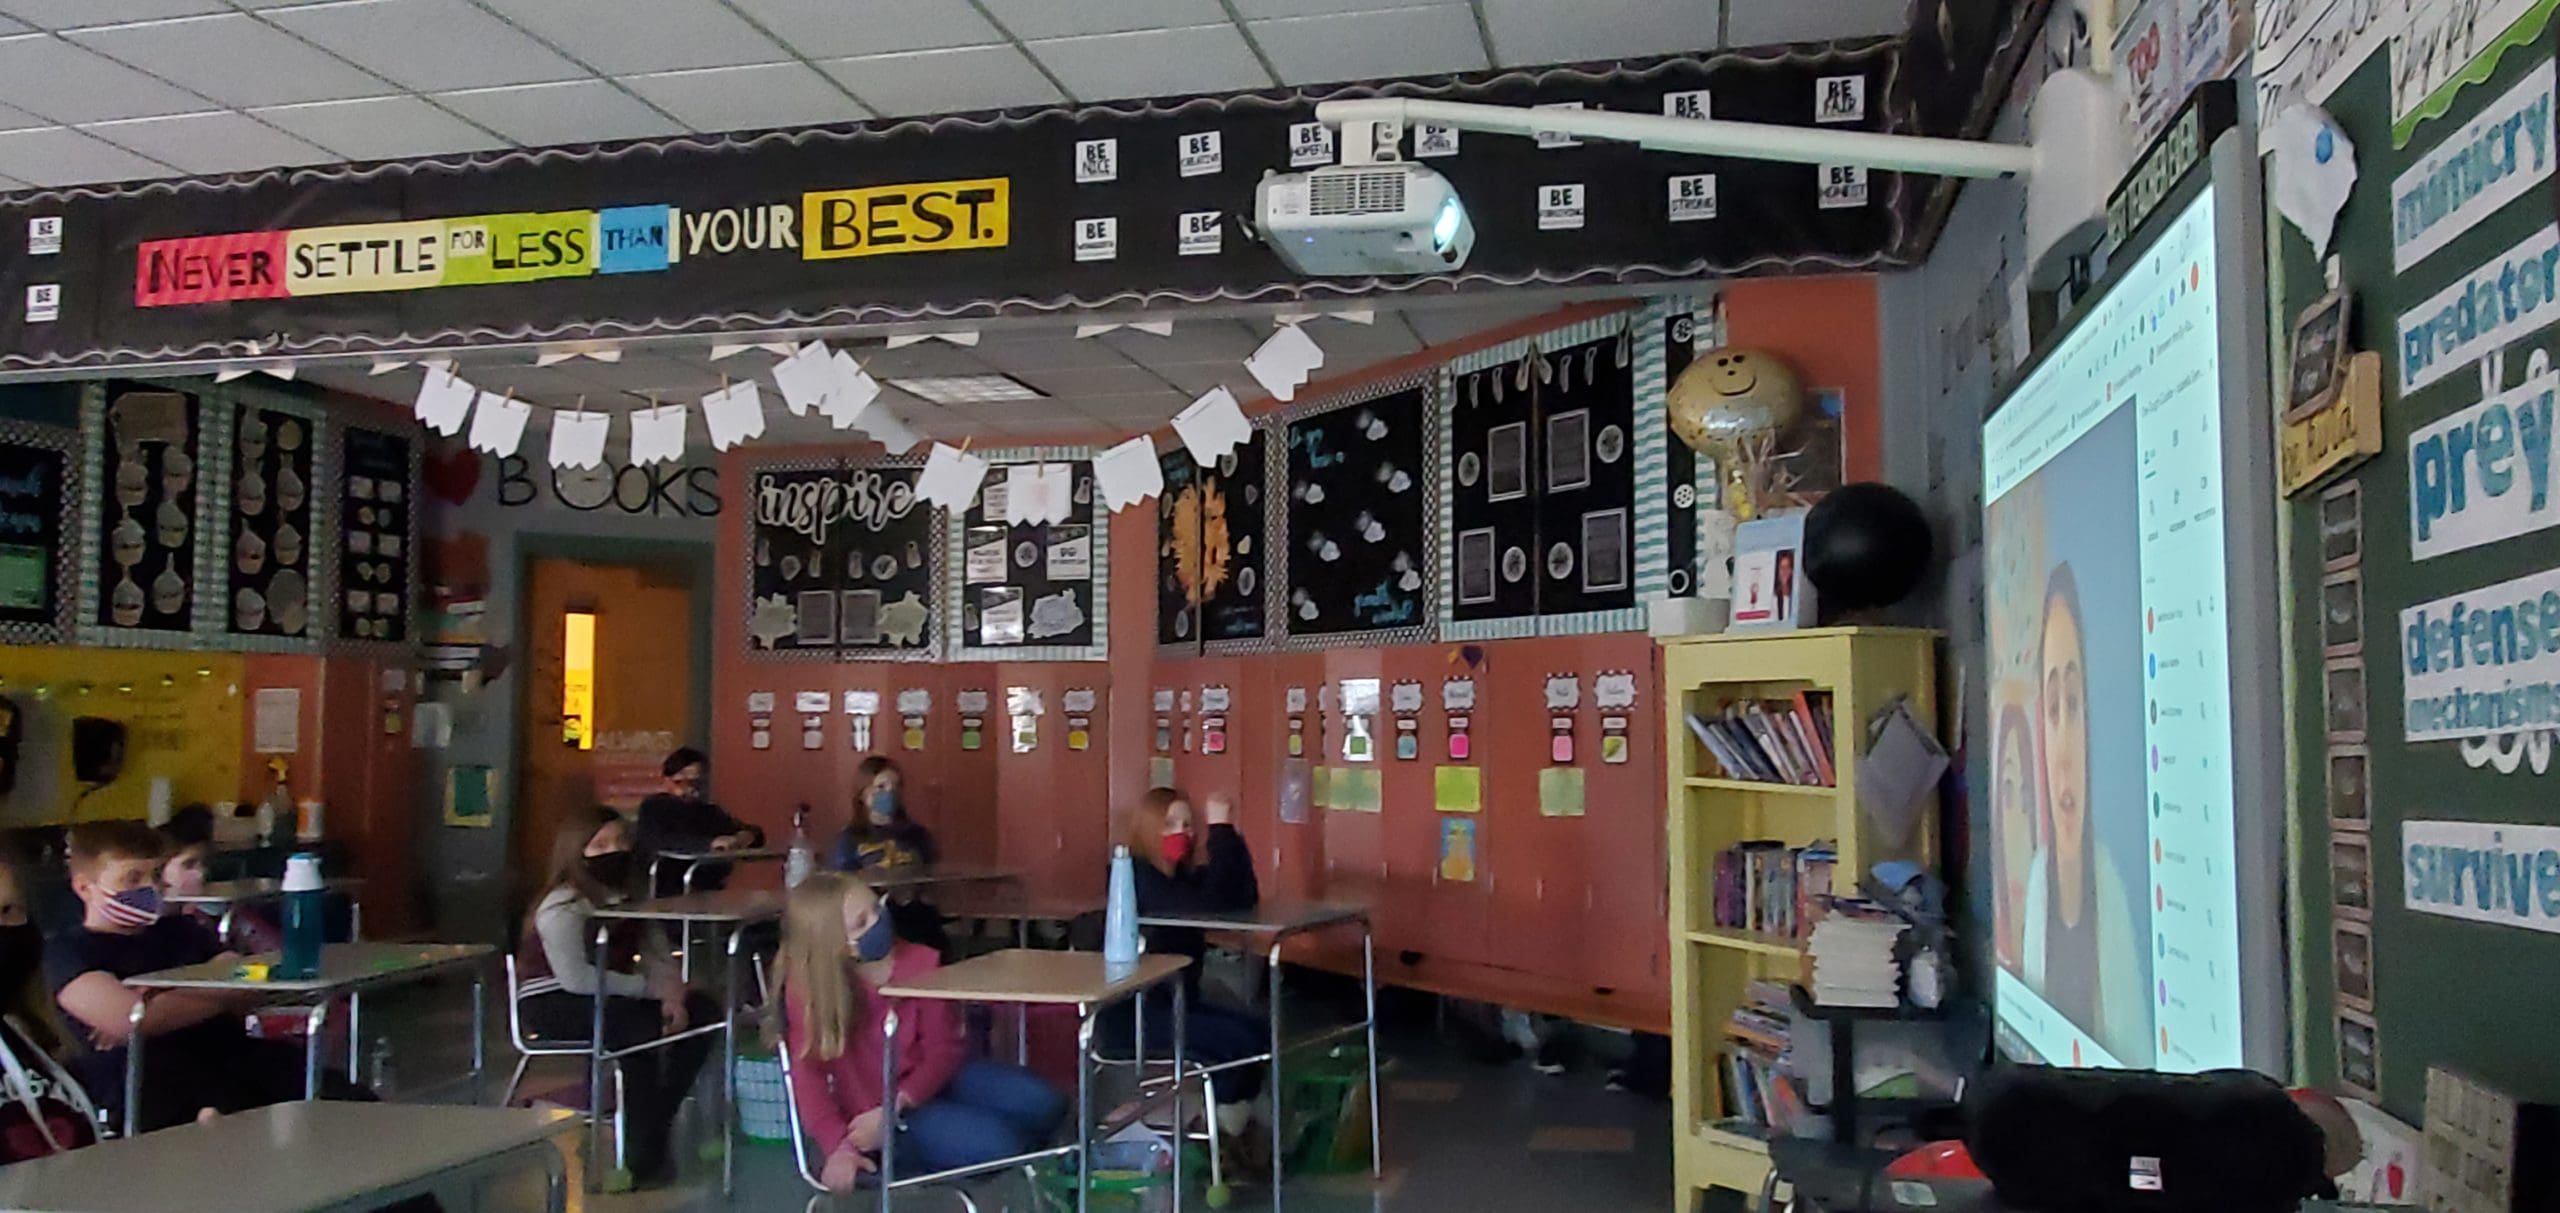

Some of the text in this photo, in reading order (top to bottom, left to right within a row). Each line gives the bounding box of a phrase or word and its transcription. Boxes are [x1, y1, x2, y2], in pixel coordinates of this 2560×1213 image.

[1829, 80, 1852, 99] BE
[1676, 95, 1699, 114] BE
[1301, 126, 1322, 144] BE
[1087, 143, 1107, 161] BE
[1190, 136, 1210, 154] BE
[1083, 159, 1110, 175] NICE
[1831, 166, 1855, 184] BE
[2397, 92, 2550, 248] mimicry
[1681, 178, 1704, 197] BE
[1550, 189, 1572, 206] BE
[1086, 222, 1106, 239] BE
[1190, 217, 1211, 233] BE
[149, 189, 996, 294] NEVER SETTLE FOR LESS THAN YOUR BEST.
[2404, 243, 2560, 386] predator
[2414, 389, 2554, 542] prey
[498, 454, 722, 518] BOOKS
[758, 469, 917, 545] inspire
[2408, 589, 2560, 676] defense
[2410, 831, 2560, 918] survive
